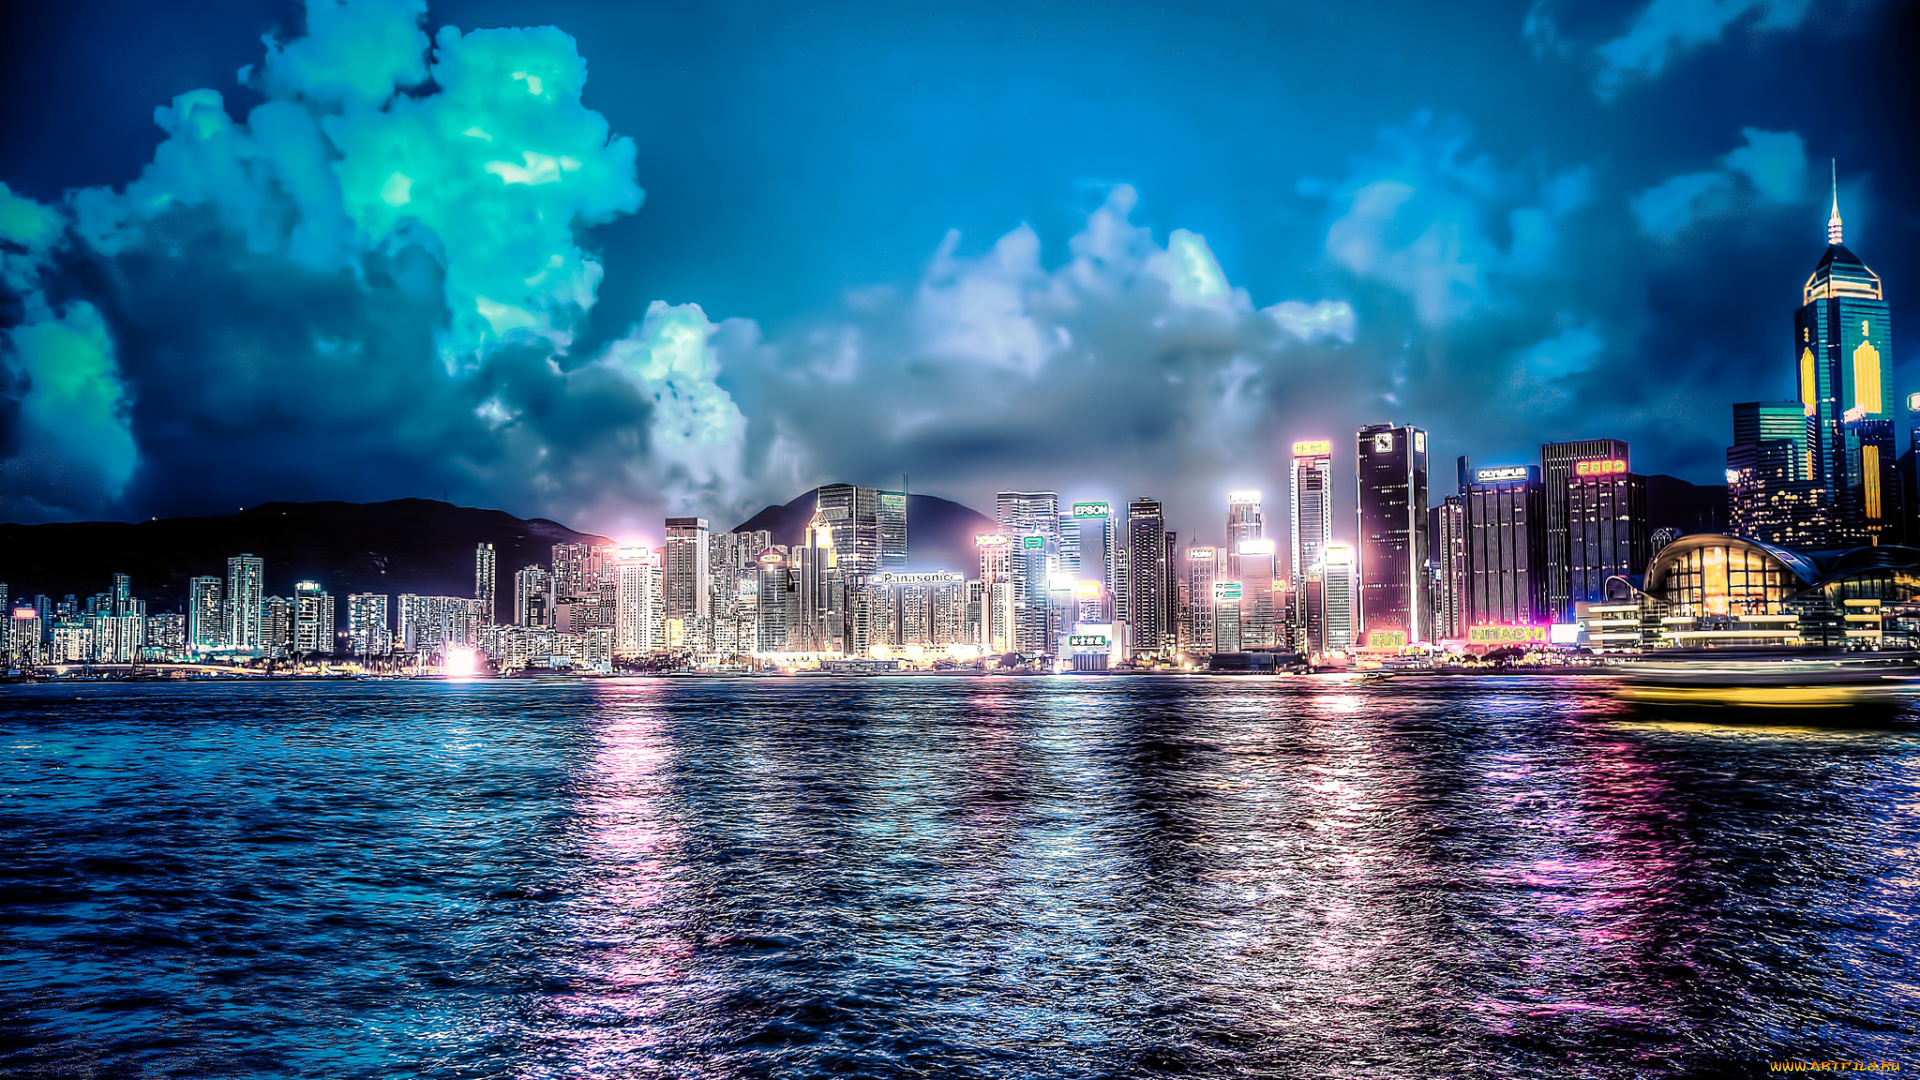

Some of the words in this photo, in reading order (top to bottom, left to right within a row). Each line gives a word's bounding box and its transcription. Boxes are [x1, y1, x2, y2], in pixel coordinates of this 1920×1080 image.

[1478, 467, 1527, 479] OLYMPUS
[1074, 505, 1108, 516] EPSON
[884, 570, 953, 584] Panasonic
[1470, 626, 1546, 642] HITACHI
